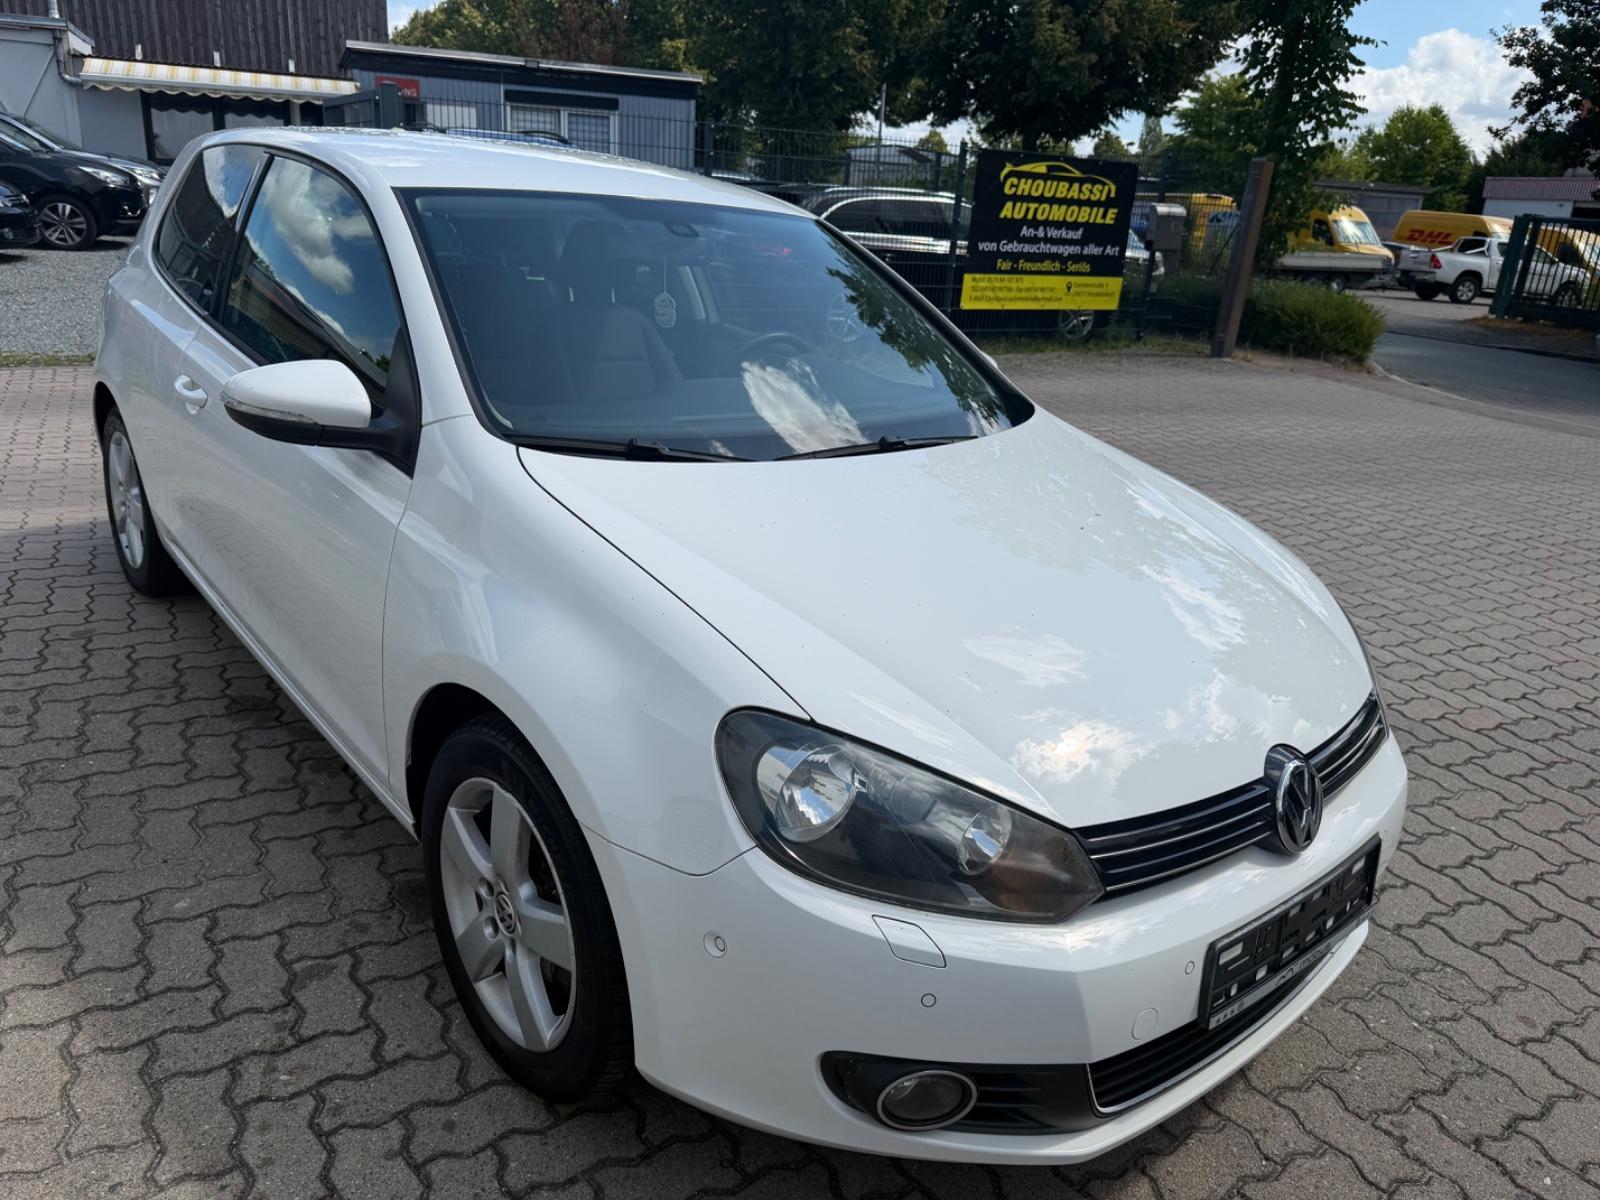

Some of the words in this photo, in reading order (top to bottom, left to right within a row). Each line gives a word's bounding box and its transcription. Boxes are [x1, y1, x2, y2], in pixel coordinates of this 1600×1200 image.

[1004, 177, 1108, 200] CHOUBASSI
[1000, 201, 1118, 224] AUTOMOBILE
[1047, 227, 1083, 239] Verkauf
[1407, 229, 1453, 245] DHL
[978, 242, 998, 251] von
[999, 240, 1081, 256] Gebrauchtwagen
[1082, 244, 1103, 255] aller
[1104, 245, 1120, 256] Art
[996, 259, 1012, 270] Fair
[1018, 259, 1060, 271] Freundlich
